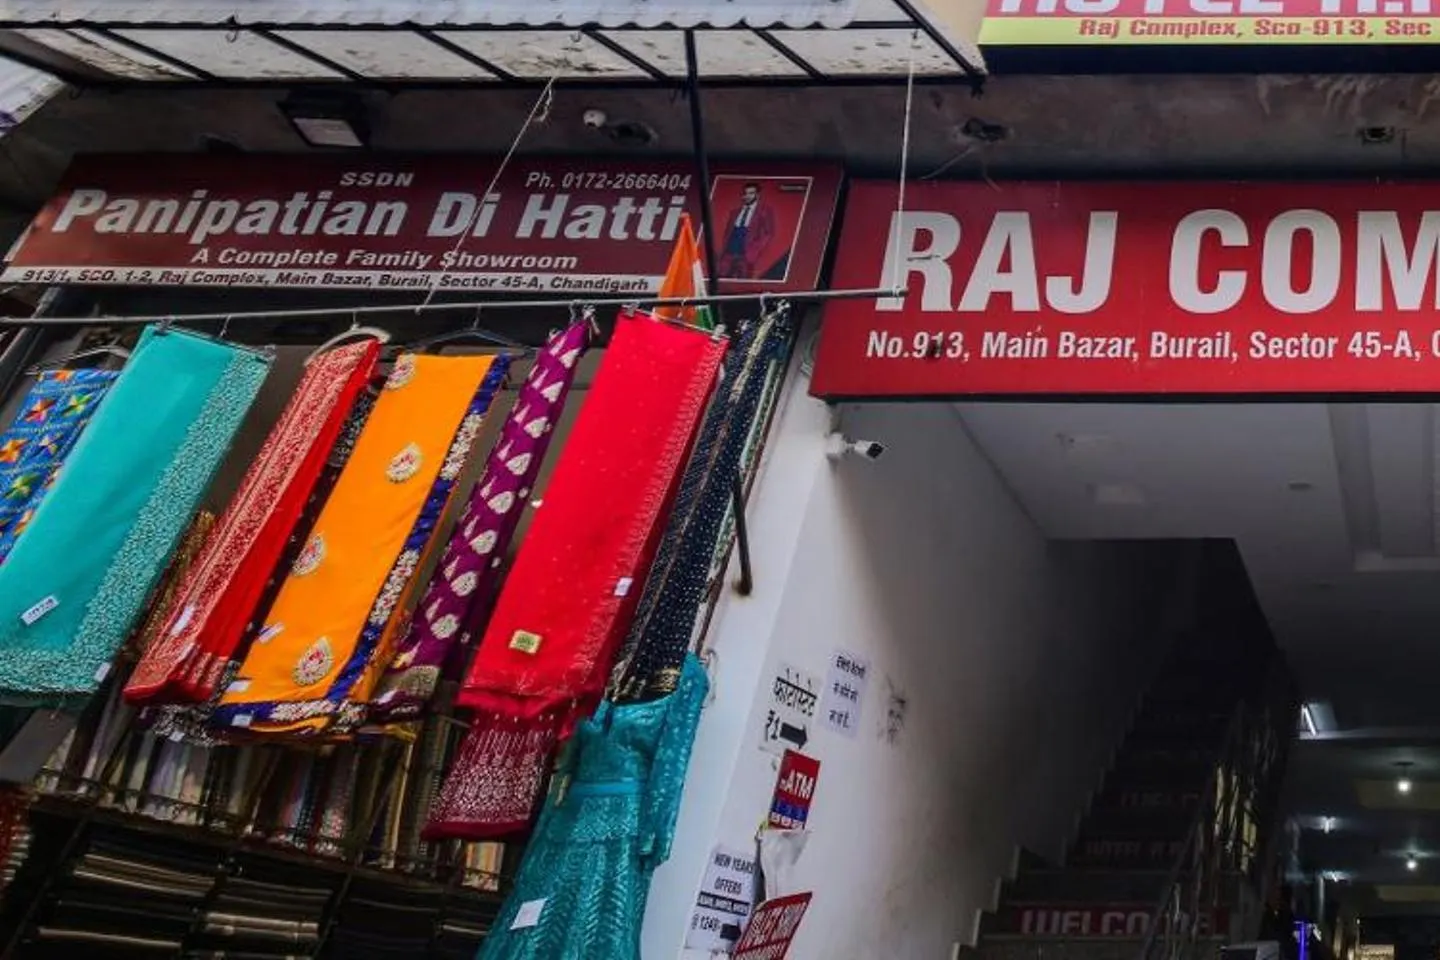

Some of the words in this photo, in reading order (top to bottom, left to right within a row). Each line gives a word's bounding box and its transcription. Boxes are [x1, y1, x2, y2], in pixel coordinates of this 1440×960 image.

[1079, 19, 1119, 38] Raj
[1129, 19, 1244, 38] Complex,
[1385, 19, 1431, 36] Sec
[340, 172, 413, 187] SSDN
[525, 172, 555, 188] Ph.
[562, 172, 691, 189] 0172-2666404
[52, 189, 408, 243] Panipatian
[427, 192, 500, 238] Di
[515, 193, 688, 240] Hatti
[191, 248, 209, 263] A
[217, 248, 337, 269] Complete
[346, 250, 431, 270] Family
[440, 250, 577, 270] Showroom
[875, 210, 1119, 313] RAJ
[159, 270, 187, 285] Raj
[192, 271, 269, 288] Complex,
[274, 272, 314, 286] Main
[320, 272, 373, 288] Bazar,
[378, 273, 434, 289] Burail,
[439, 275, 496, 288] Sector
[501, 276, 544, 290] 45-A,
[549, 277, 649, 292] Chandigarh
[866, 331, 970, 361] No.913,
[981, 330, 1048, 358] Main
[1057, 331, 1140, 362] Bazar,
[1149, 330, 1238, 363] Burail,
[1249, 330, 1339, 358] Sector
[1347, 330, 1422, 362] 45-A,
